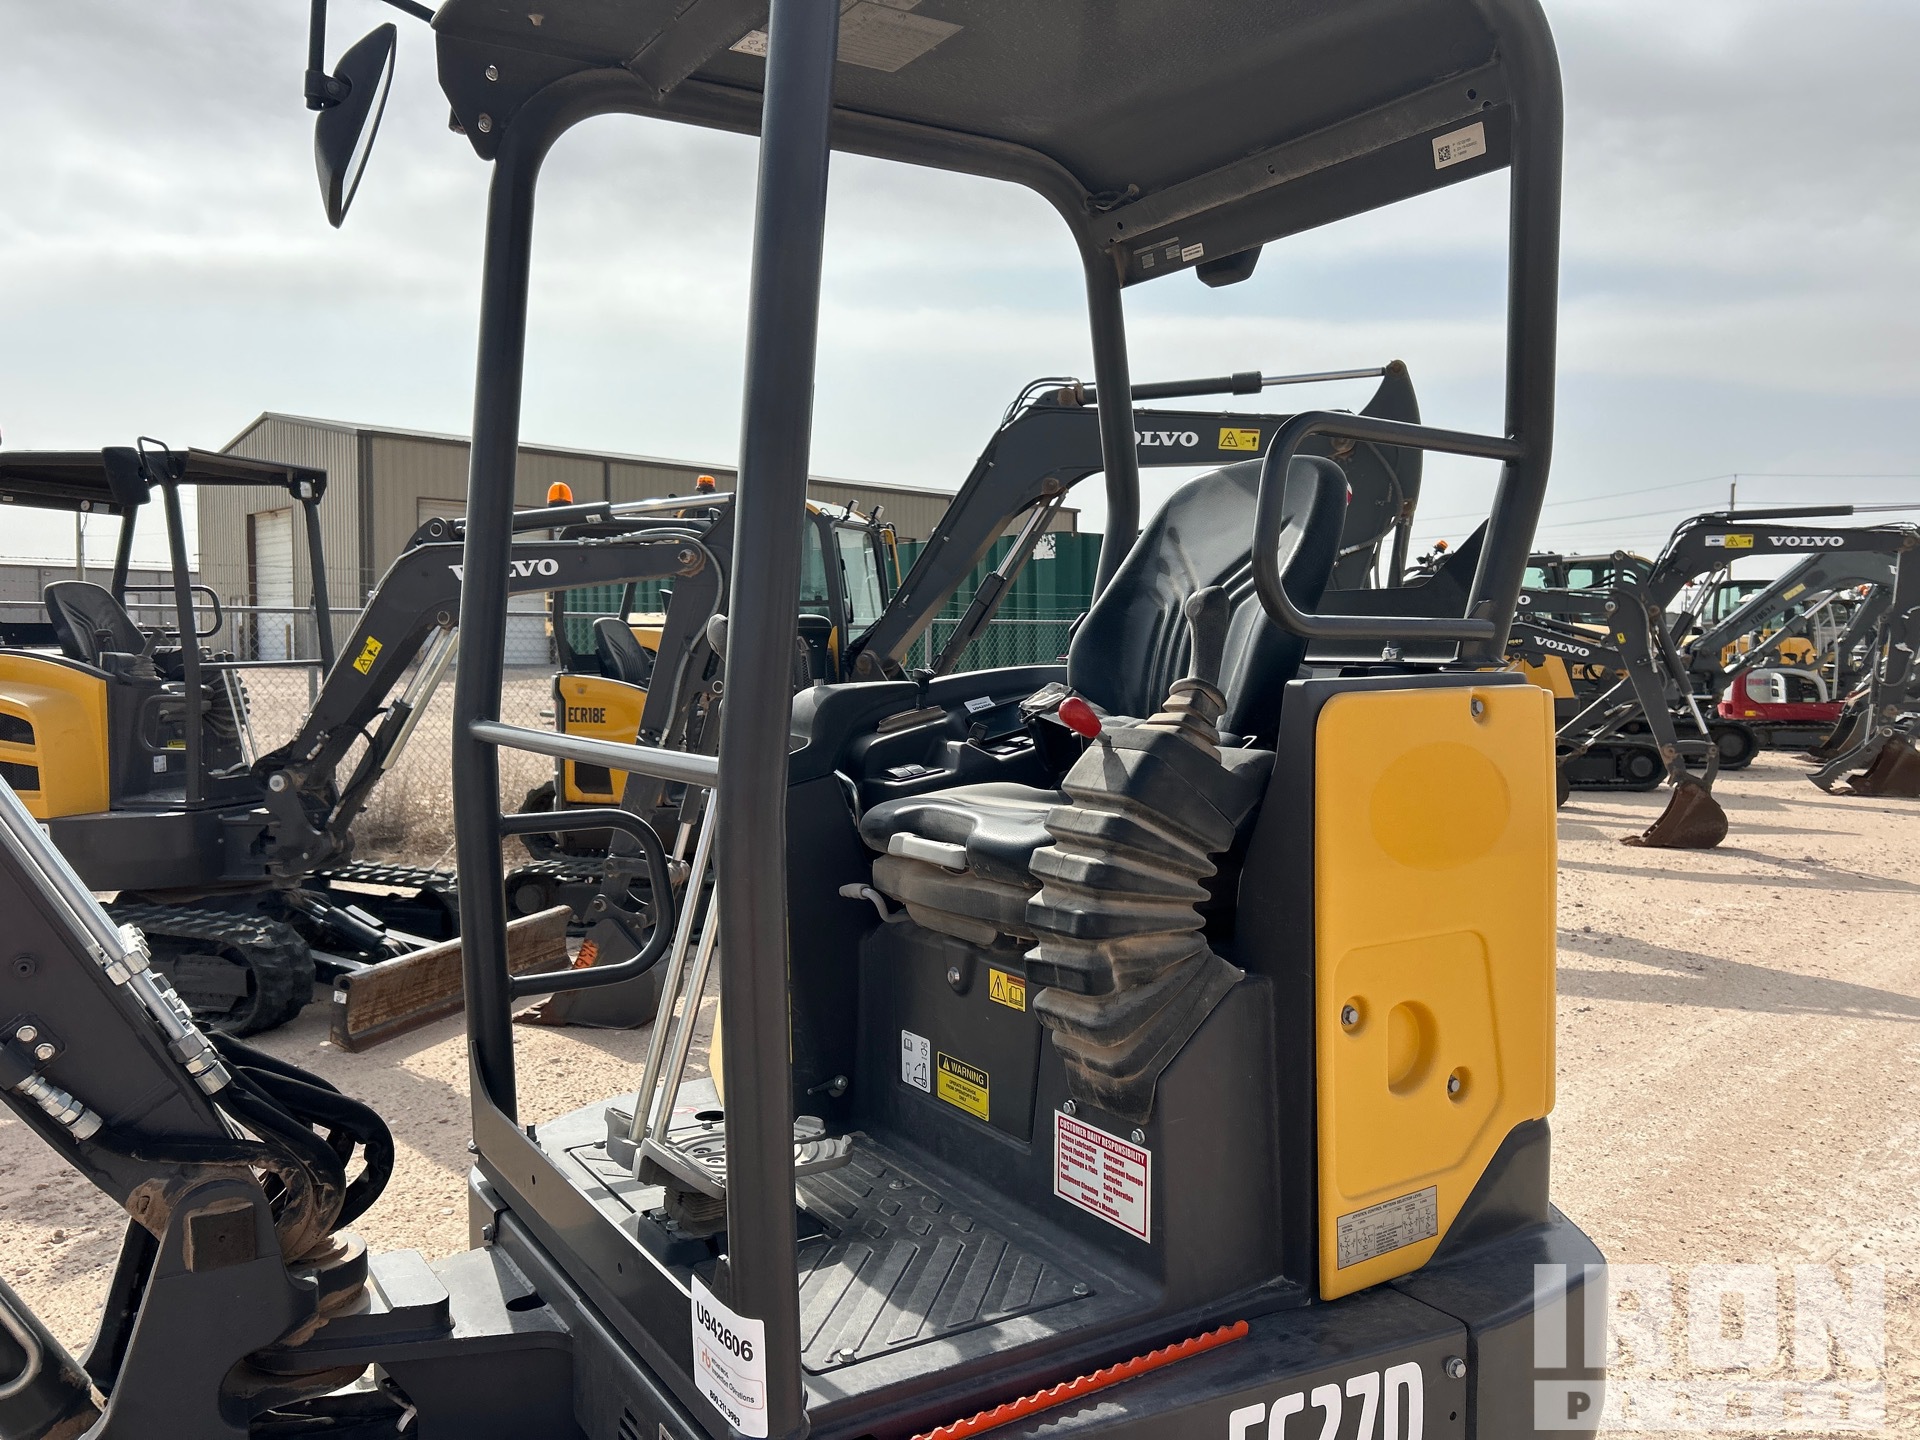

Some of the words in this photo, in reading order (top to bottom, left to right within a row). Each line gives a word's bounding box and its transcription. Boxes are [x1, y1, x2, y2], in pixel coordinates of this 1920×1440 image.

[1768, 536, 1844, 547] VOLVO
[448, 558, 559, 581] VVO
[1534, 636, 1590, 657] VOLVO
[568, 706, 606, 723] ECR18E
[950, 1061, 984, 1085] WARNING
[1060, 1118, 1086, 1138] CUSTOMER
[1087, 1130, 1101, 1144] DAILY
[1101, 1136, 1144, 1164] RESPONSIBILITY
[1061, 1132, 1073, 1144] Grease
[1074, 1138, 1096, 1154] Lubrication
[1061, 1142, 1071, 1153] Check
[1073, 1147, 1084, 1158] Fluids
[1085, 1153, 1094, 1164] Daily
[1103, 1152, 1124, 1167] Overspray
[1069, 1155, 1084, 1169] Damage
[1087, 1165, 1097, 1175] Flats
[1103, 1162, 1125, 1179] Equipment
[1125, 1172, 1142, 1187] Damage
[1061, 1171, 1080, 1187] Equipment
[1081, 1181, 1098, 1196] Cleaning
[1103, 1172, 1121, 1187] Batteries
[1103, 1182, 1112, 1192] Safe
[1113, 1187, 1133, 1203] Operation
[1103, 1193, 1112, 1203] Keys
[1081, 1192, 1101, 1208] Operator's
[1102, 1202, 1119, 1217] Manuals
[696, 1300, 753, 1361] U942606
[711, 1367, 729, 1389] Inspection
[729, 1382, 755, 1404] Operations
